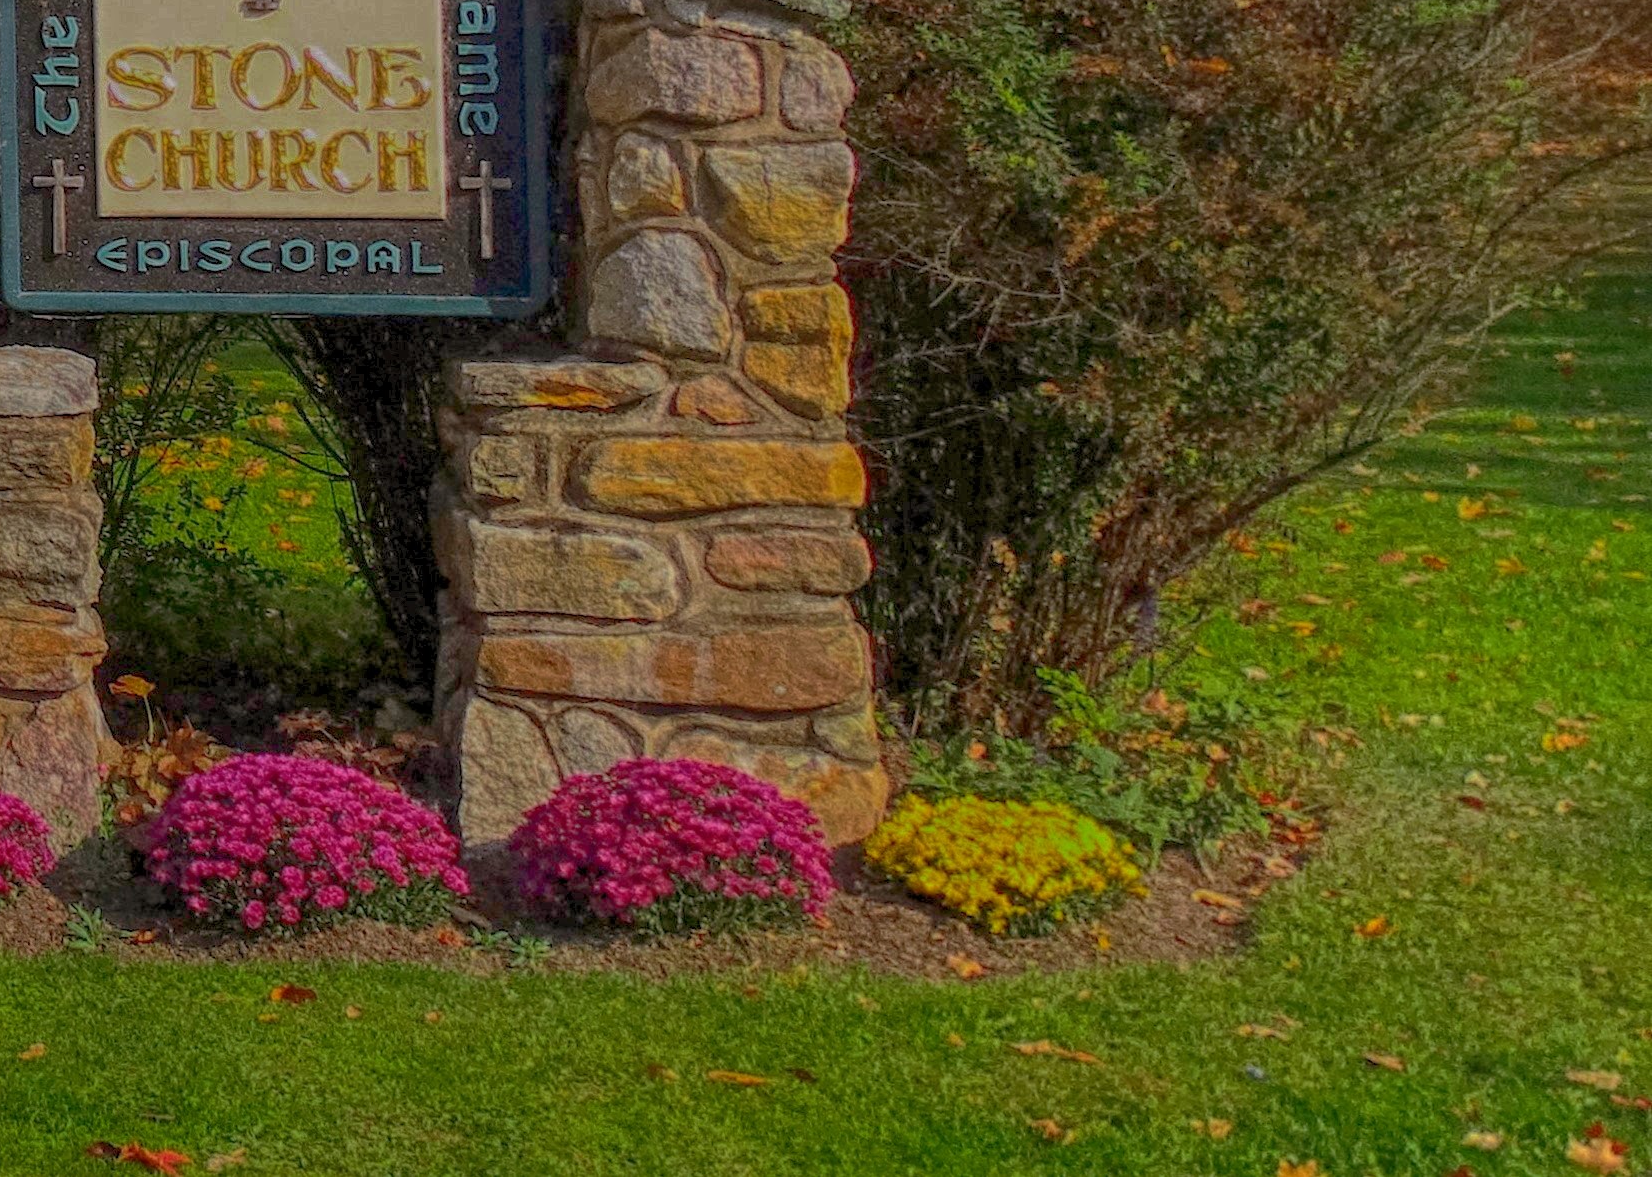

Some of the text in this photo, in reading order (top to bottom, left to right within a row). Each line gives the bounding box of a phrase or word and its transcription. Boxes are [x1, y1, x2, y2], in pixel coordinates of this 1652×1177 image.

[33, 13, 80, 137] The
[105, 41, 433, 113] STONE
[103, 125, 430, 194] CHURCH
[96, 237, 445, 275] EPISCOPAL
